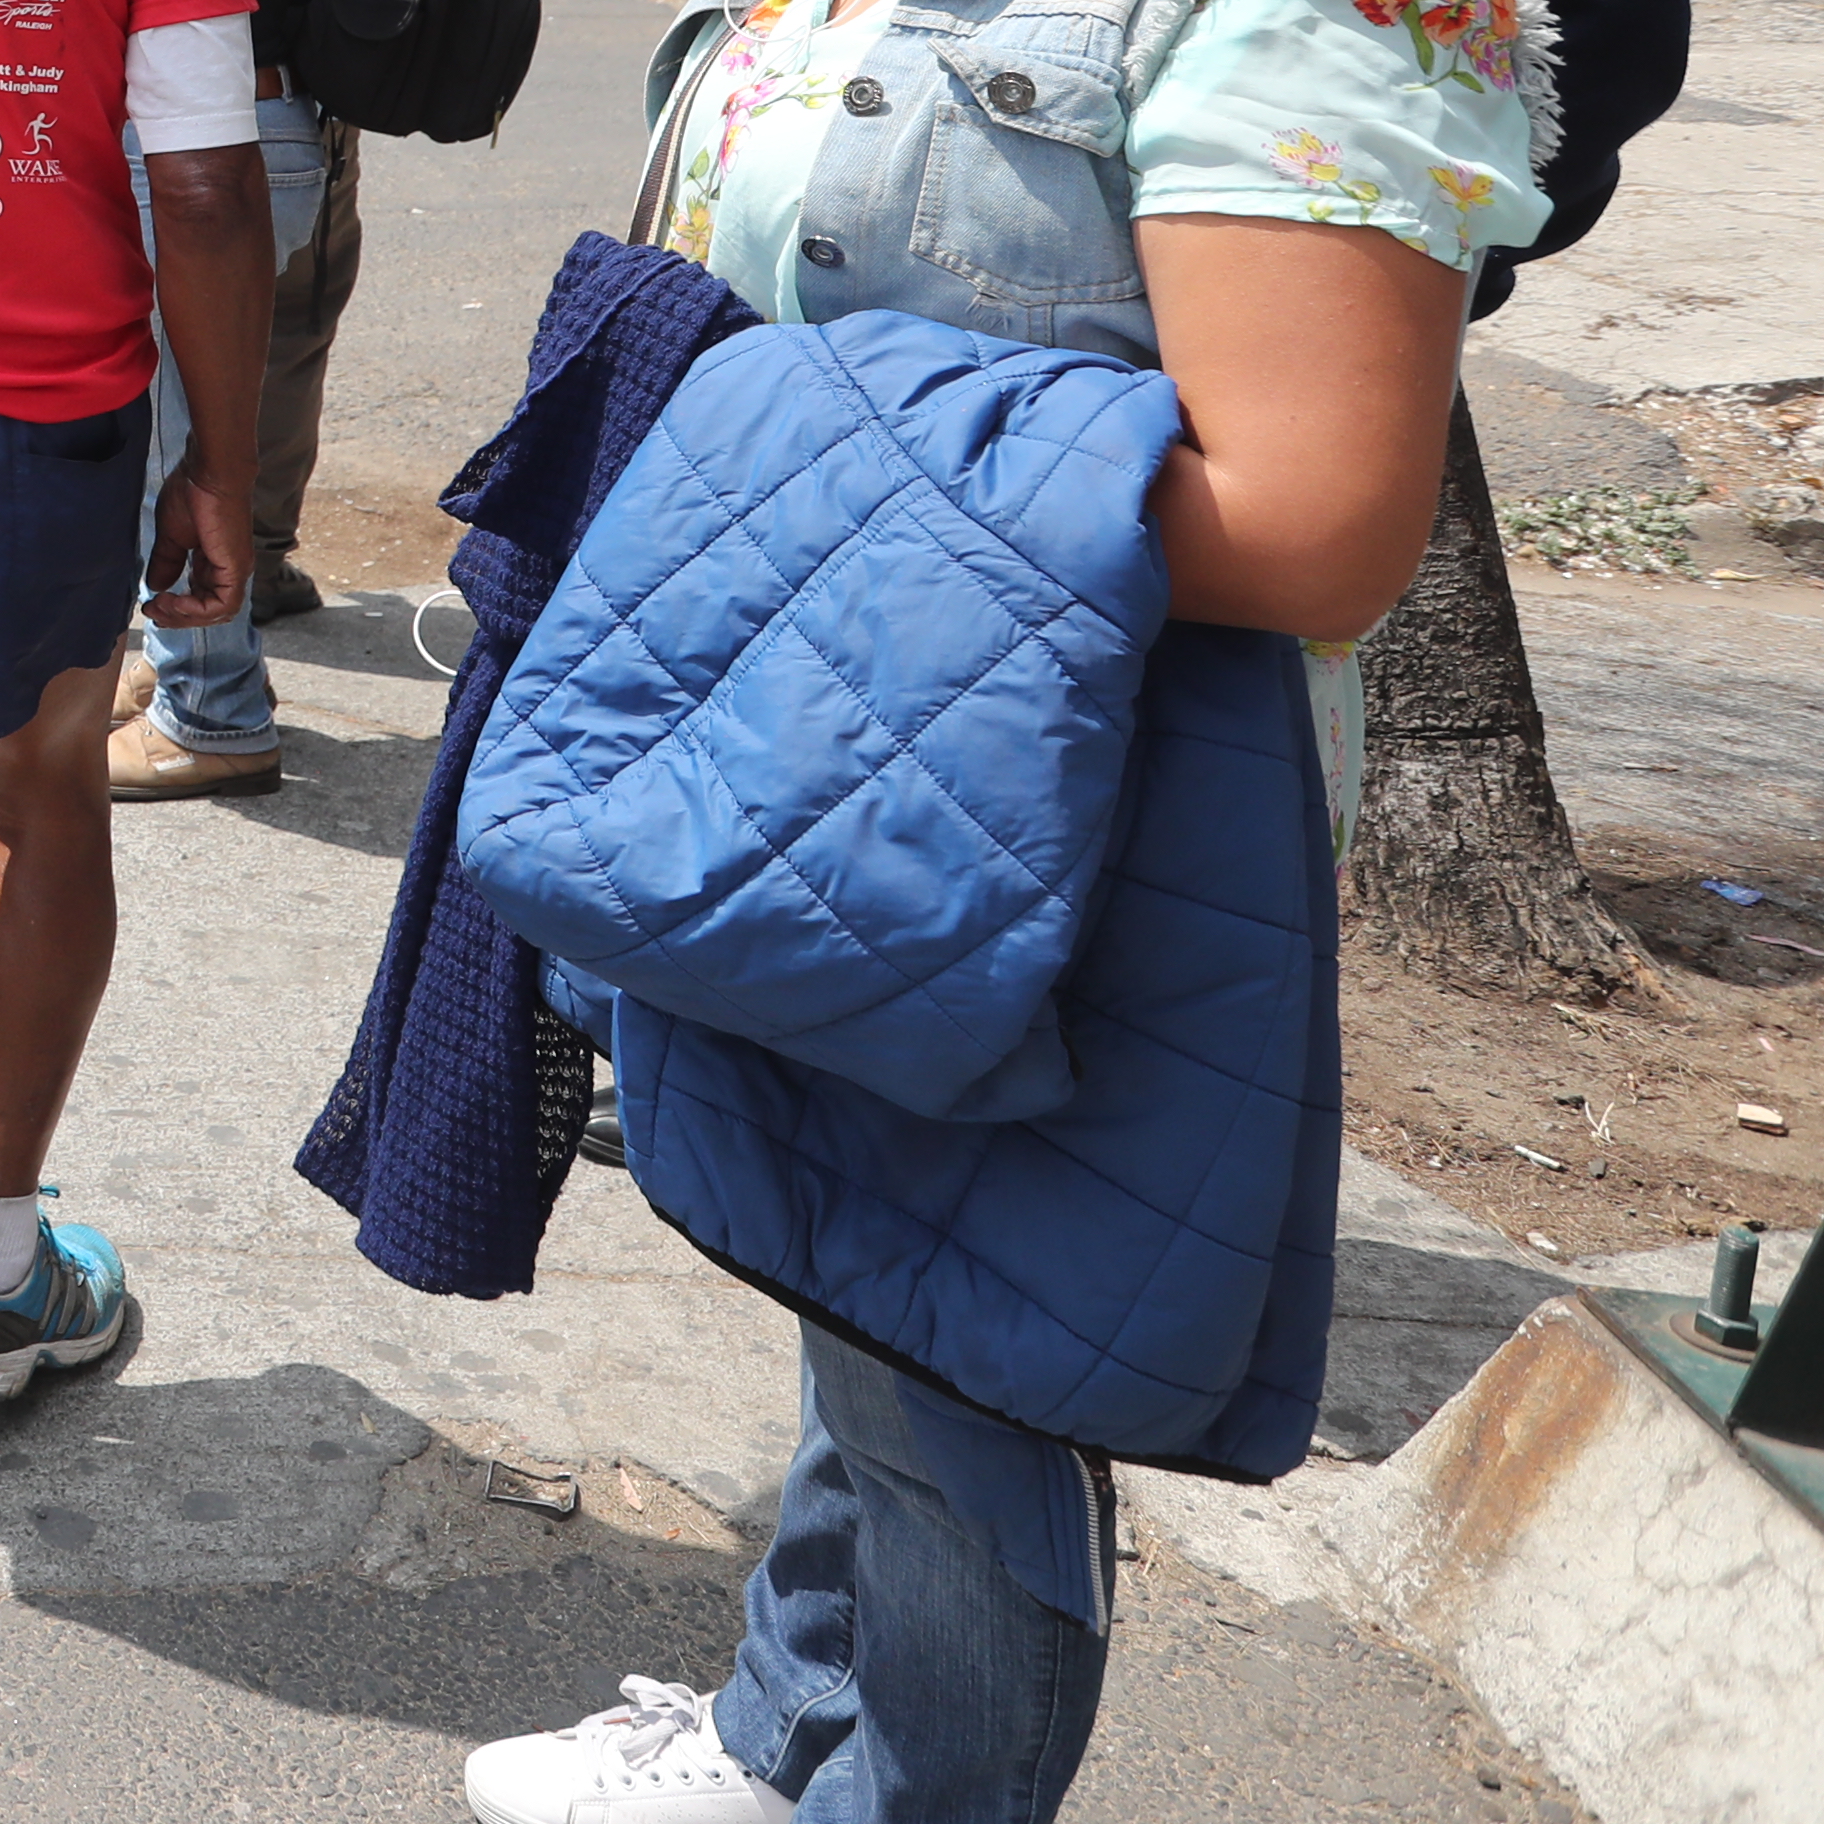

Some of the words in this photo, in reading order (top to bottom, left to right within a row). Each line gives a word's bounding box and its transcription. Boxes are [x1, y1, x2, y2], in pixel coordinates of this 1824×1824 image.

[15, 21, 53, 30] RALEIGH
[15, 65, 25, 76] &
[28, 66, 64, 80] Judy
